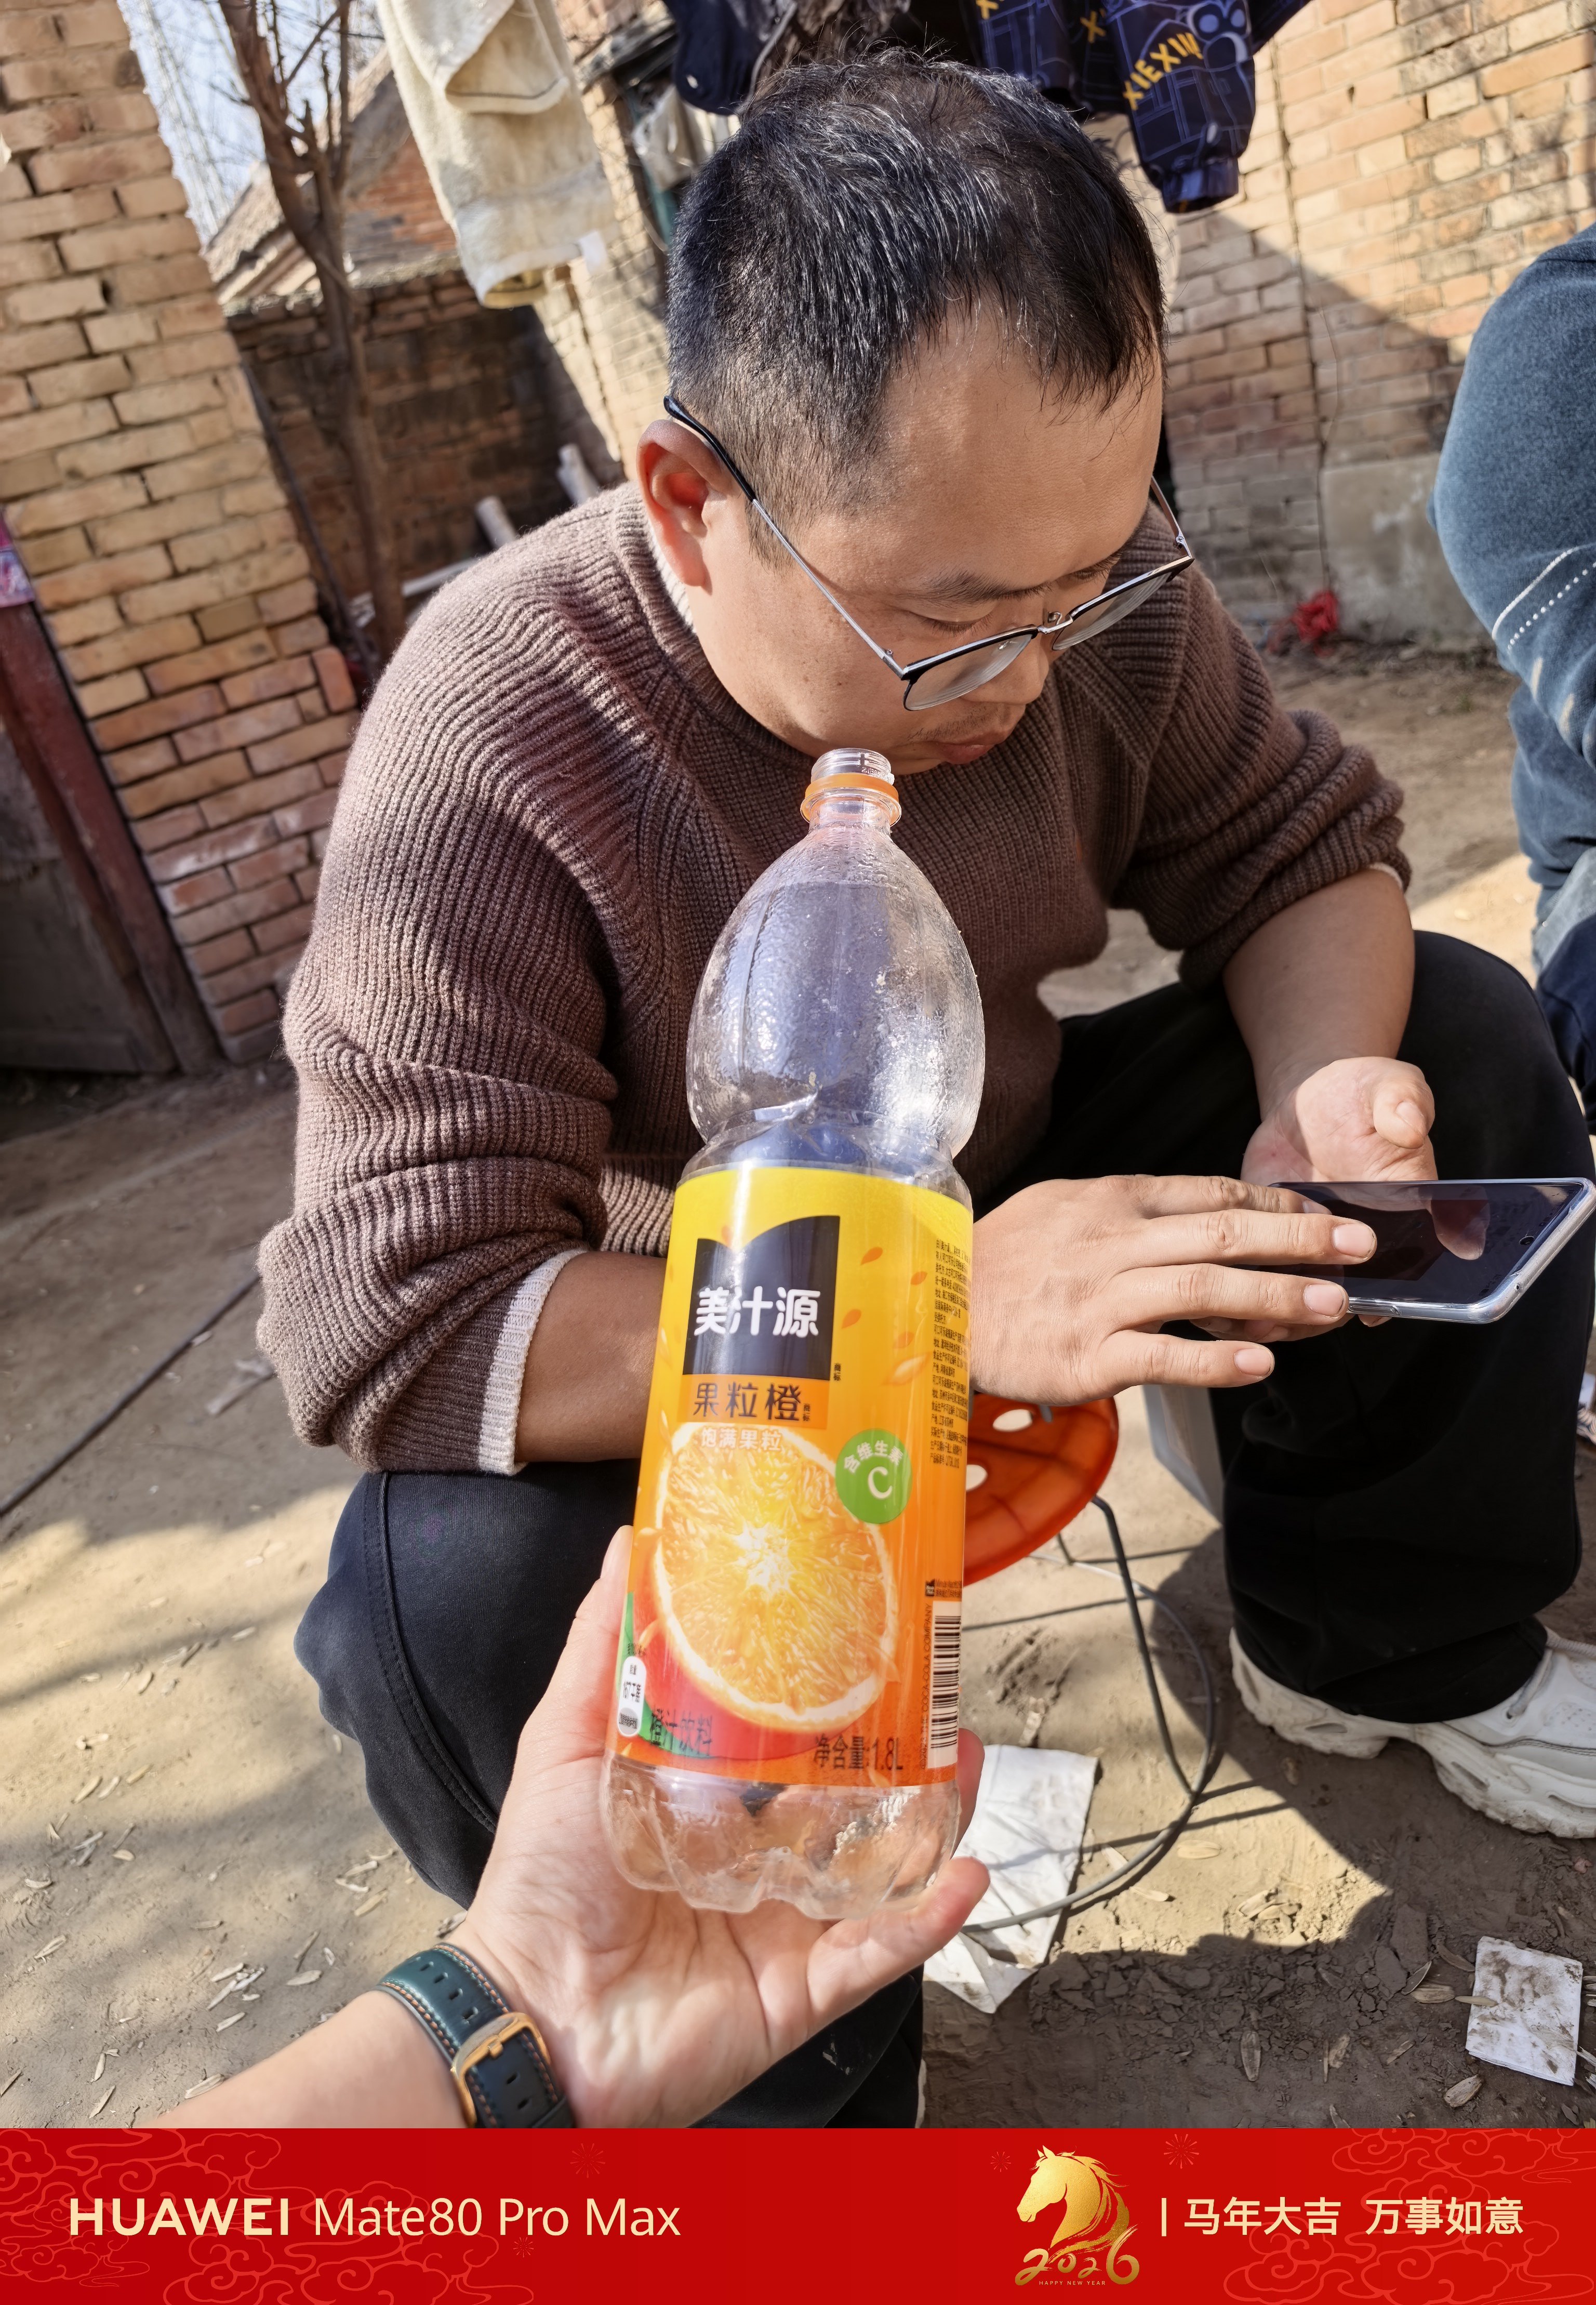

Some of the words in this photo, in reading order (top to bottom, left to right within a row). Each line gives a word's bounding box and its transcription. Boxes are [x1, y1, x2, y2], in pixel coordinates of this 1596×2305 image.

[694, 1286, 821, 1338] 美汁源
[693, 1382, 802, 1421] 果粒橙
[701, 1426, 781, 1451] 饱满果粒
[843, 1440, 903, 1474] 含维生素
[867, 1466, 893, 1500] C
[923, 1603, 932, 1652] COMPANY
[649, 1704, 712, 1756] 橙汁饮料
